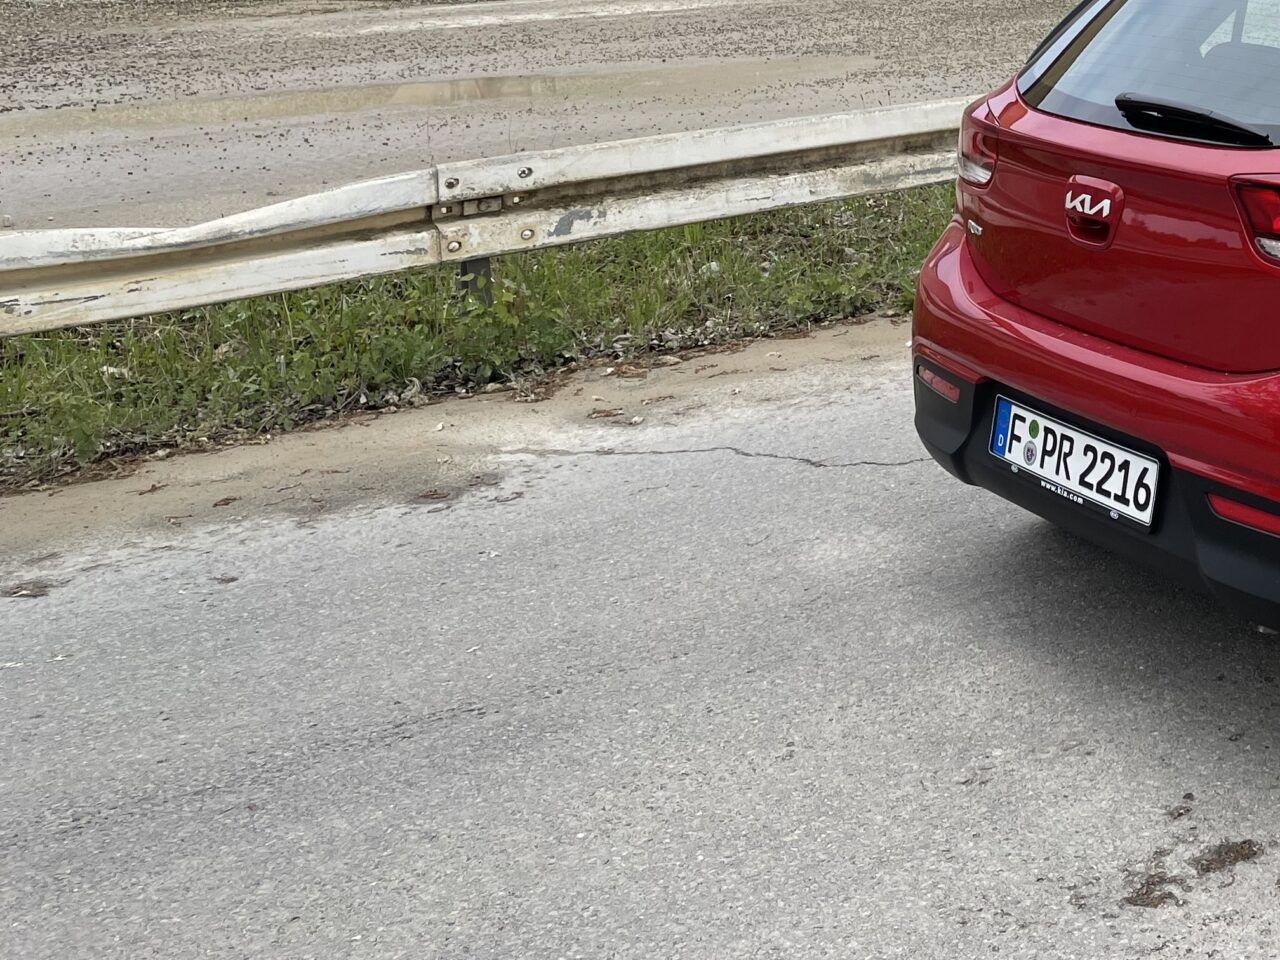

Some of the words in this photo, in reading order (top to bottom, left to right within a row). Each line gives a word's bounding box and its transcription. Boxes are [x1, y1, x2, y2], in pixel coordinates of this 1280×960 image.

[1065, 190, 1111, 218] KIA
[997, 434, 1004, 447] D
[1008, 413, 1026, 454] F
[1040, 425, 1075, 481] PR
[1078, 443, 1152, 512] 2216
[1040, 480, 1084, 505] www.kia.com
